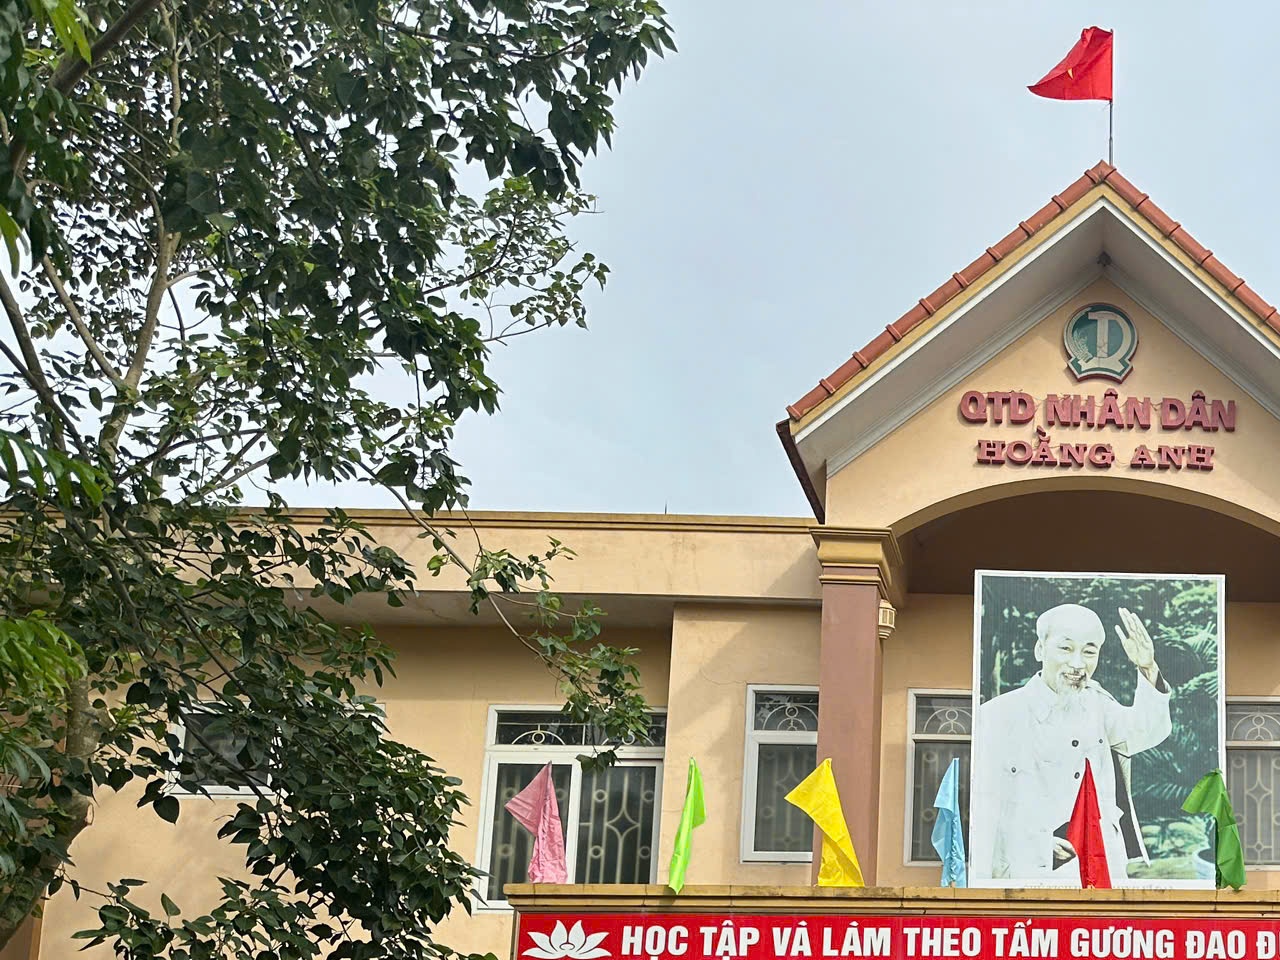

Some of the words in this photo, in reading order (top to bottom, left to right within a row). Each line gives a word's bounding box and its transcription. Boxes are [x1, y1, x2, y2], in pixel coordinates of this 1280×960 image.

[960, 390, 1035, 424] QTD
[1046, 388, 1151, 429] NHÂN
[1161, 390, 1236, 432] DÂN
[977, 425, 1115, 468] HOẰNG
[1130, 444, 1215, 470] ANH
[621, 925, 689, 960] HỌC
[699, 919, 760, 960] TẬP
[772, 920, 812, 956] VÀ
[903, 927, 982, 957] THEO
[991, 918, 1058, 957] TẤM
[1070, 926, 1174, 958] GƯƠNG
